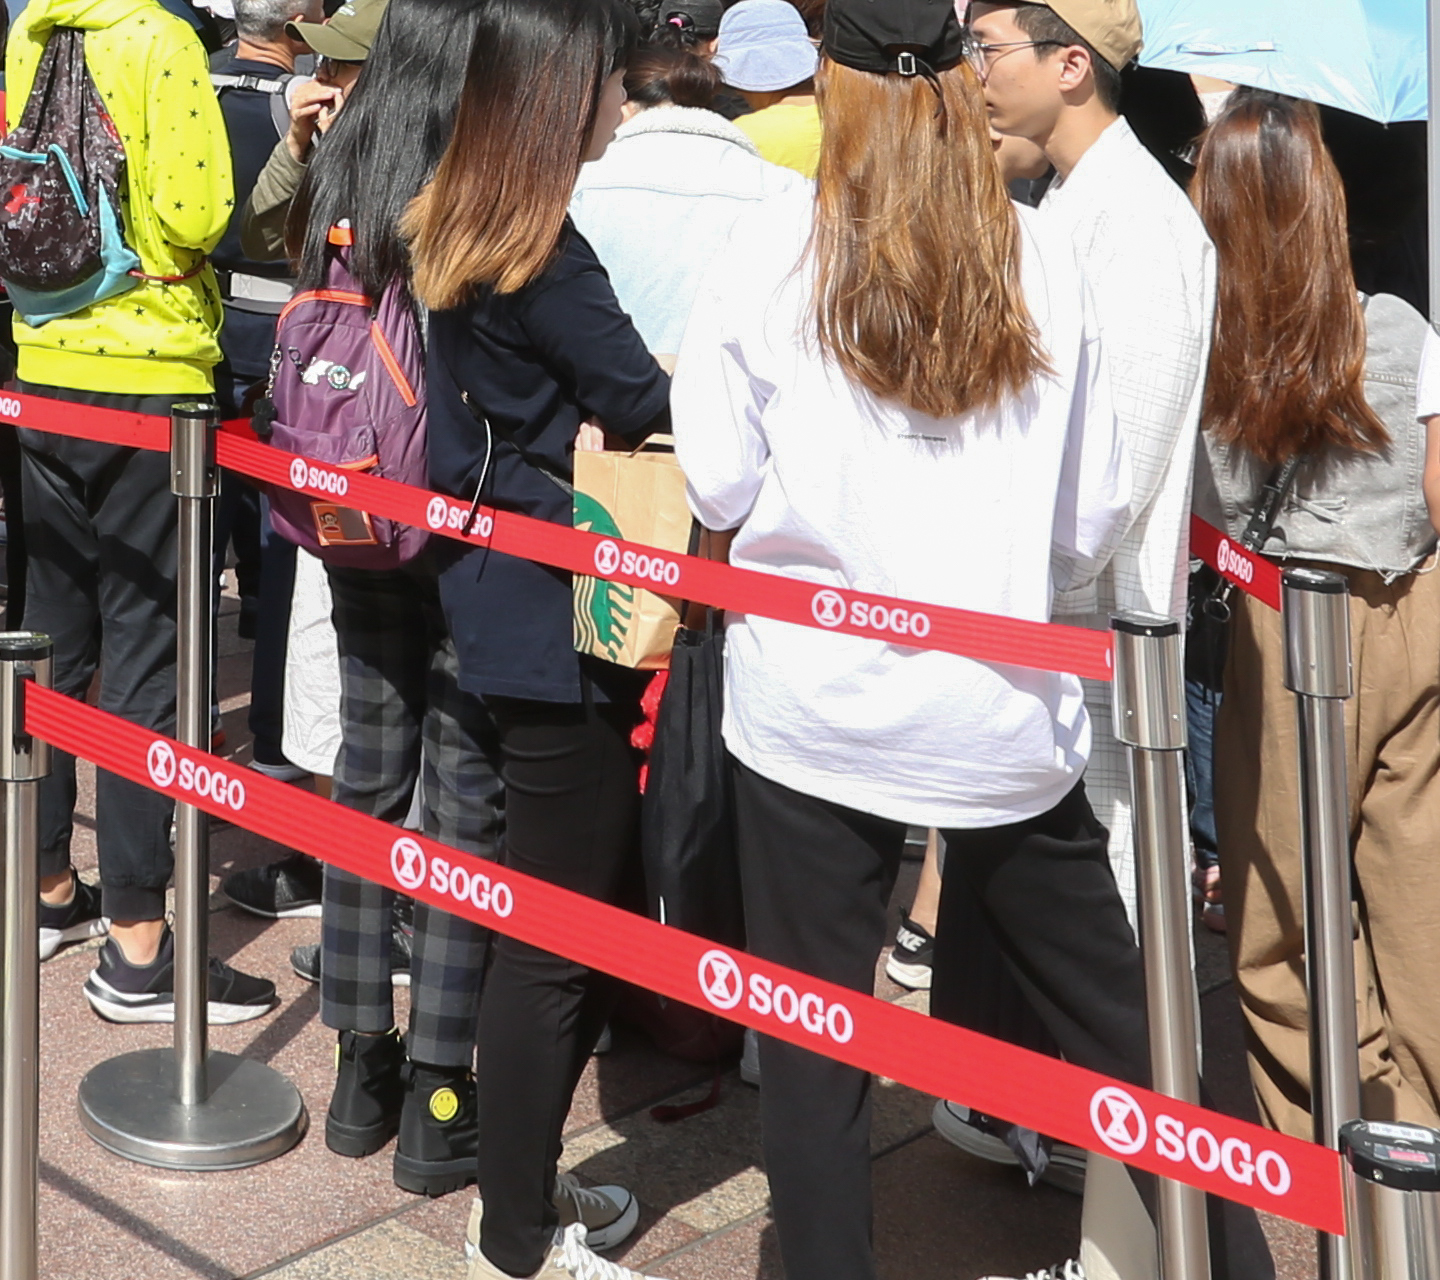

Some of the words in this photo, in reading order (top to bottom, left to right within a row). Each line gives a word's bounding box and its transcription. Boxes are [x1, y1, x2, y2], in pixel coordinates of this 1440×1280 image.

[308, 468, 348, 497] SOGO
[446, 505, 493, 539] SOGO
[619, 548, 680, 586] SOGO
[1227, 550, 1253, 583] SOGO
[850, 597, 931, 640] SOGO
[179, 764, 245, 811] SOGO
[429, 856, 514, 919] SOGO
[747, 972, 855, 1045] SOGO
[1155, 1112, 1291, 1197] SOGO
